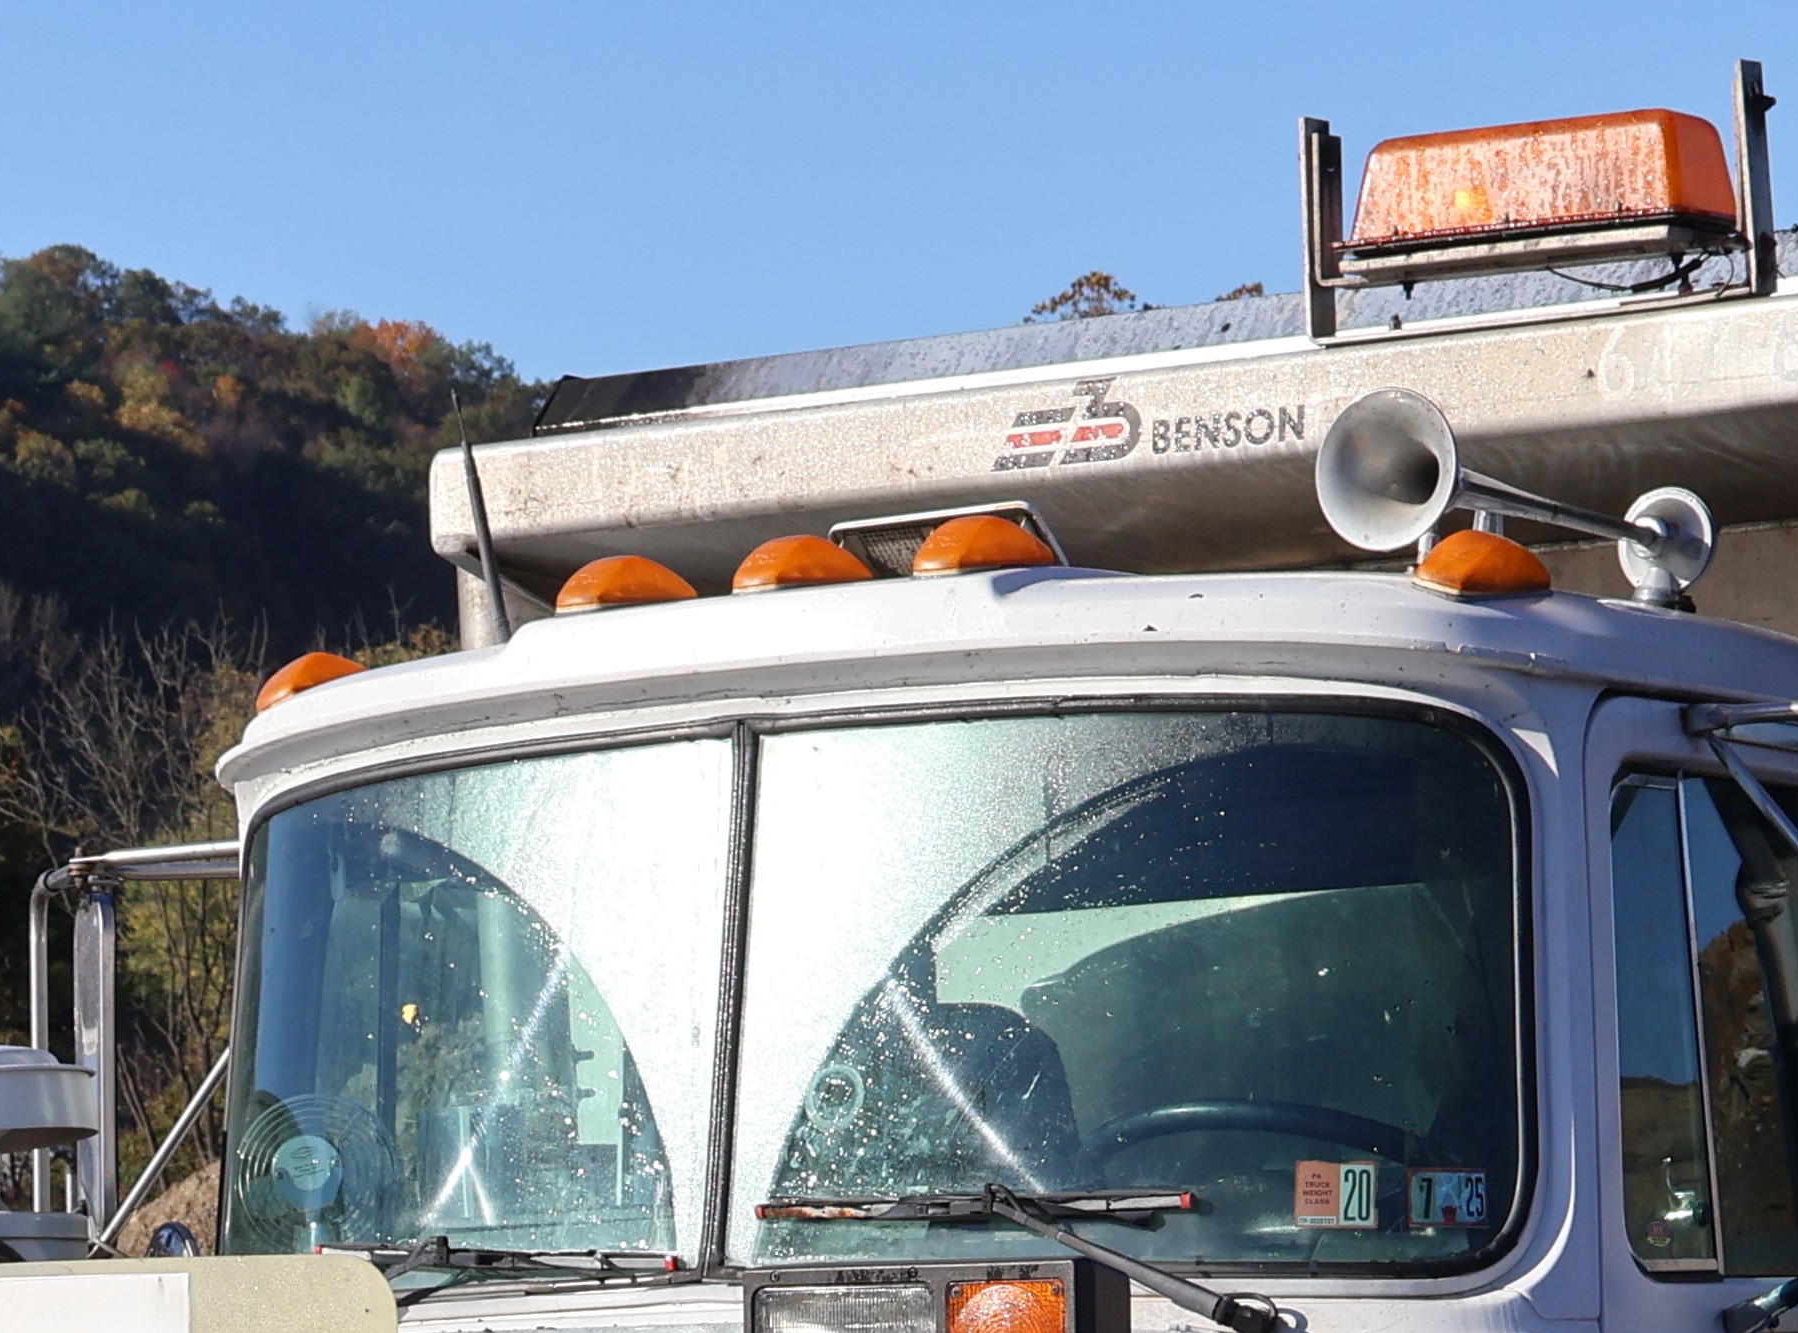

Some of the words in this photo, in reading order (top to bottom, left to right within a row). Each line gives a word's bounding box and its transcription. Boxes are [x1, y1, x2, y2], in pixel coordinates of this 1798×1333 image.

[1152, 405, 1305, 455] BENSON
[1344, 1169, 1371, 1221] 20
[1421, 1178, 1433, 1219] 7
[1465, 1177, 1484, 1217] 25
